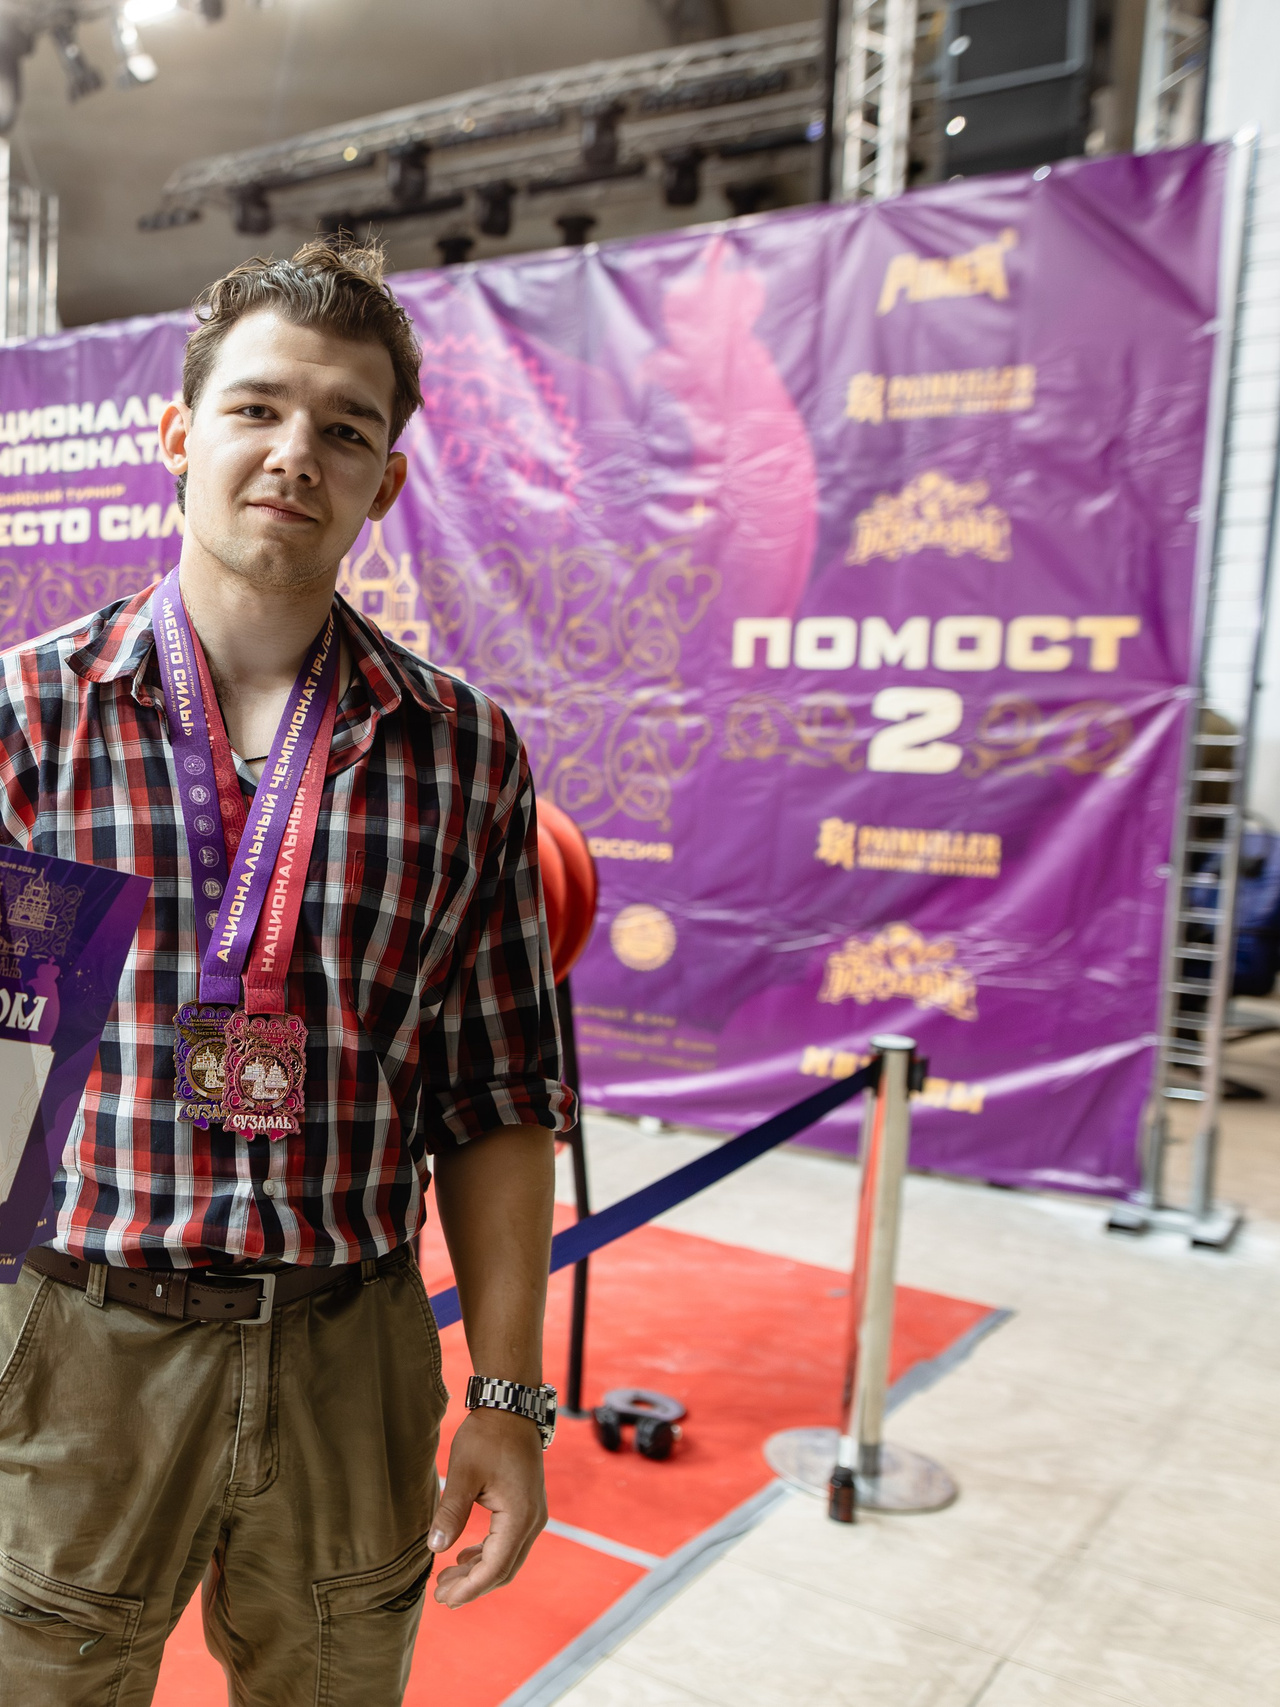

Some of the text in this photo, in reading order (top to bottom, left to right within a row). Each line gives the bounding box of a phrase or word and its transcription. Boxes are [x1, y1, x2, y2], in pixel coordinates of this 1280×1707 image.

[162, 597, 195, 737] «МЕСТО СИЛЫ»
[732, 615, 1141, 672] ПОМОСТ
[867, 686, 963, 774] 2
[216, 793, 279, 963] АЦИОНАЛЬНЫЙ
[270, 676, 318, 789] ЧЕМПИОНАТ
[232, 1114, 293, 1131] СУЗДАЛЬ
